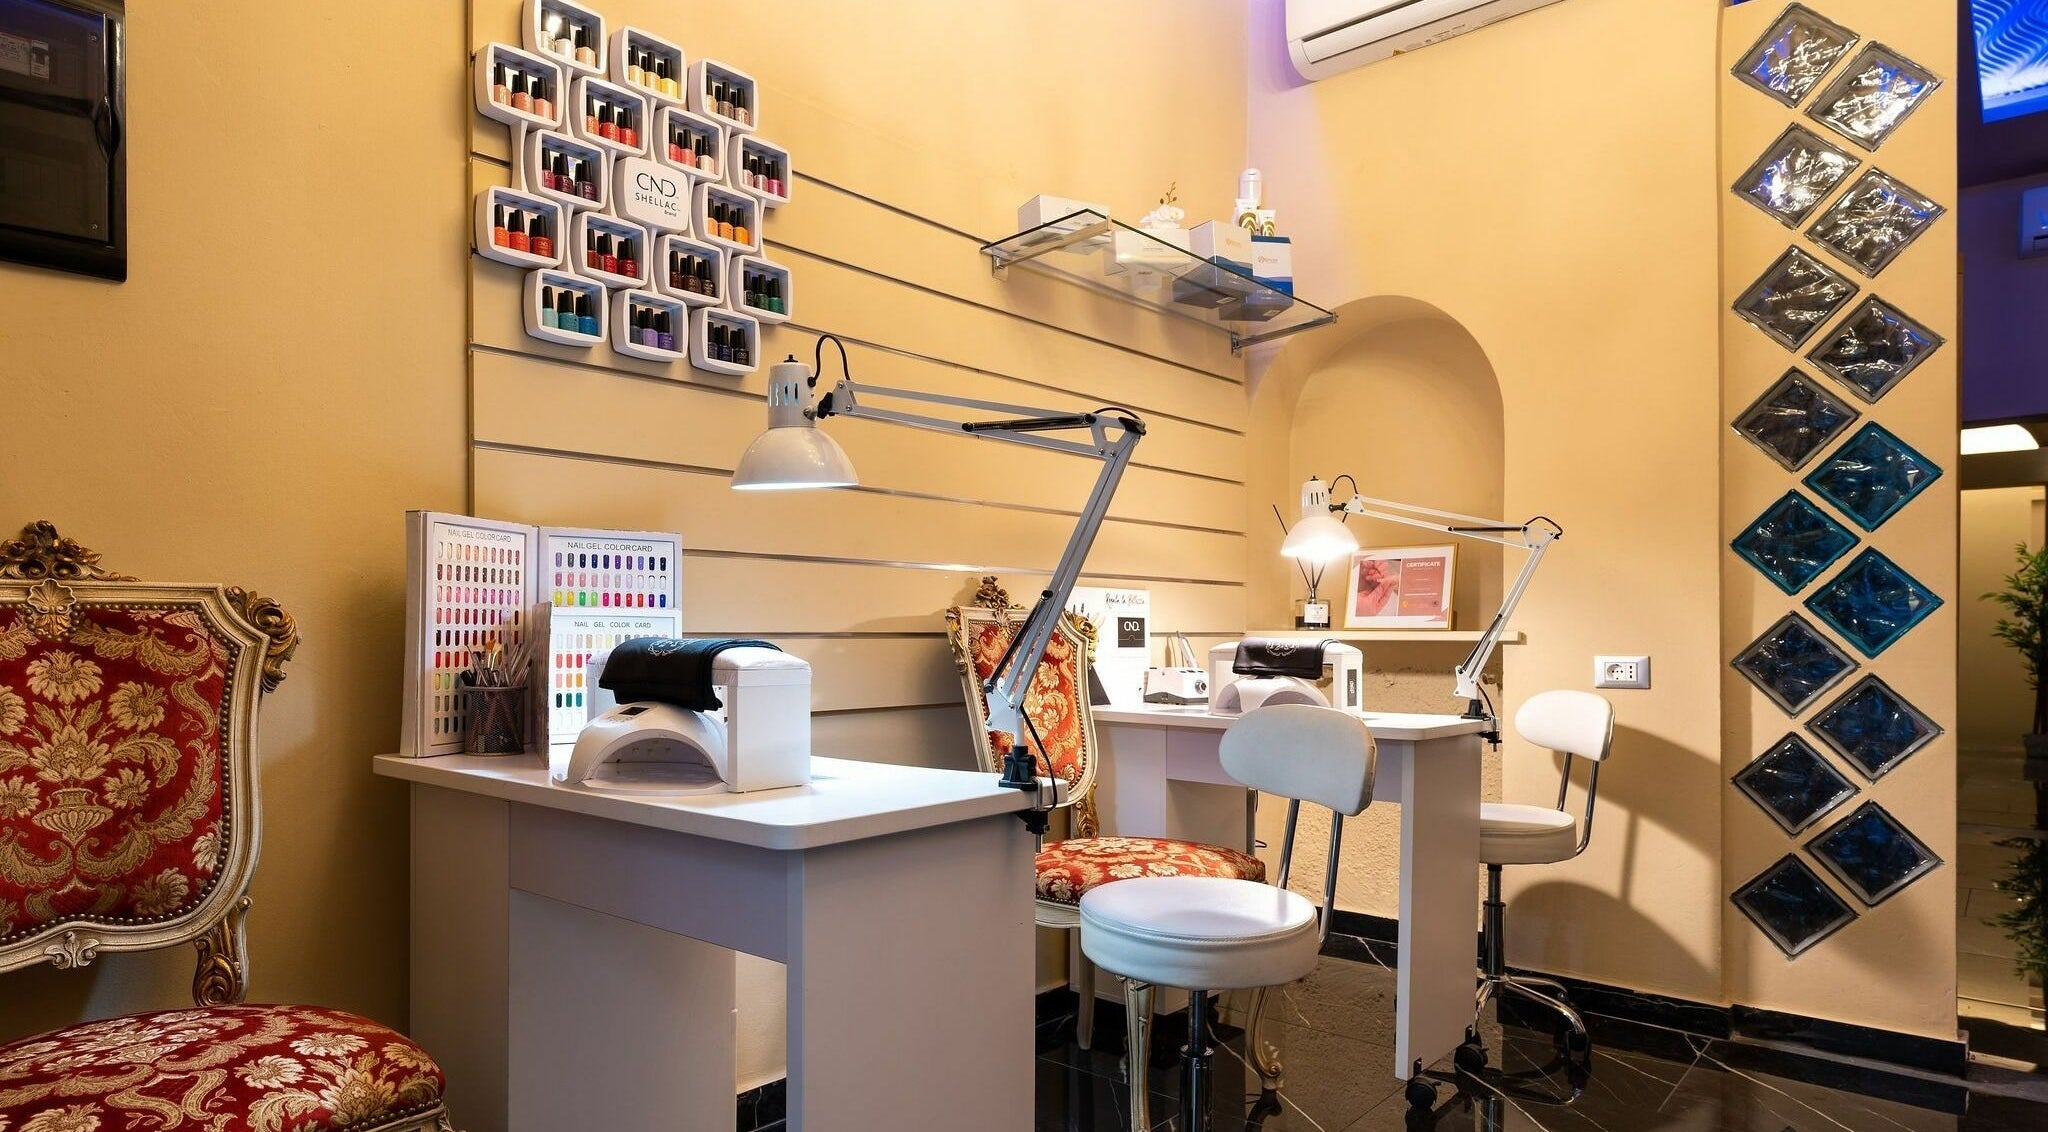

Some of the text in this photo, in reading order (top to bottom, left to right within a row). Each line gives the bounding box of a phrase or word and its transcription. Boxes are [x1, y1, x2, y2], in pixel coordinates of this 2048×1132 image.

[636, 172, 677, 198] CND
[635, 192, 678, 212] SHELLAC
[586, 542, 602, 550] GEL
